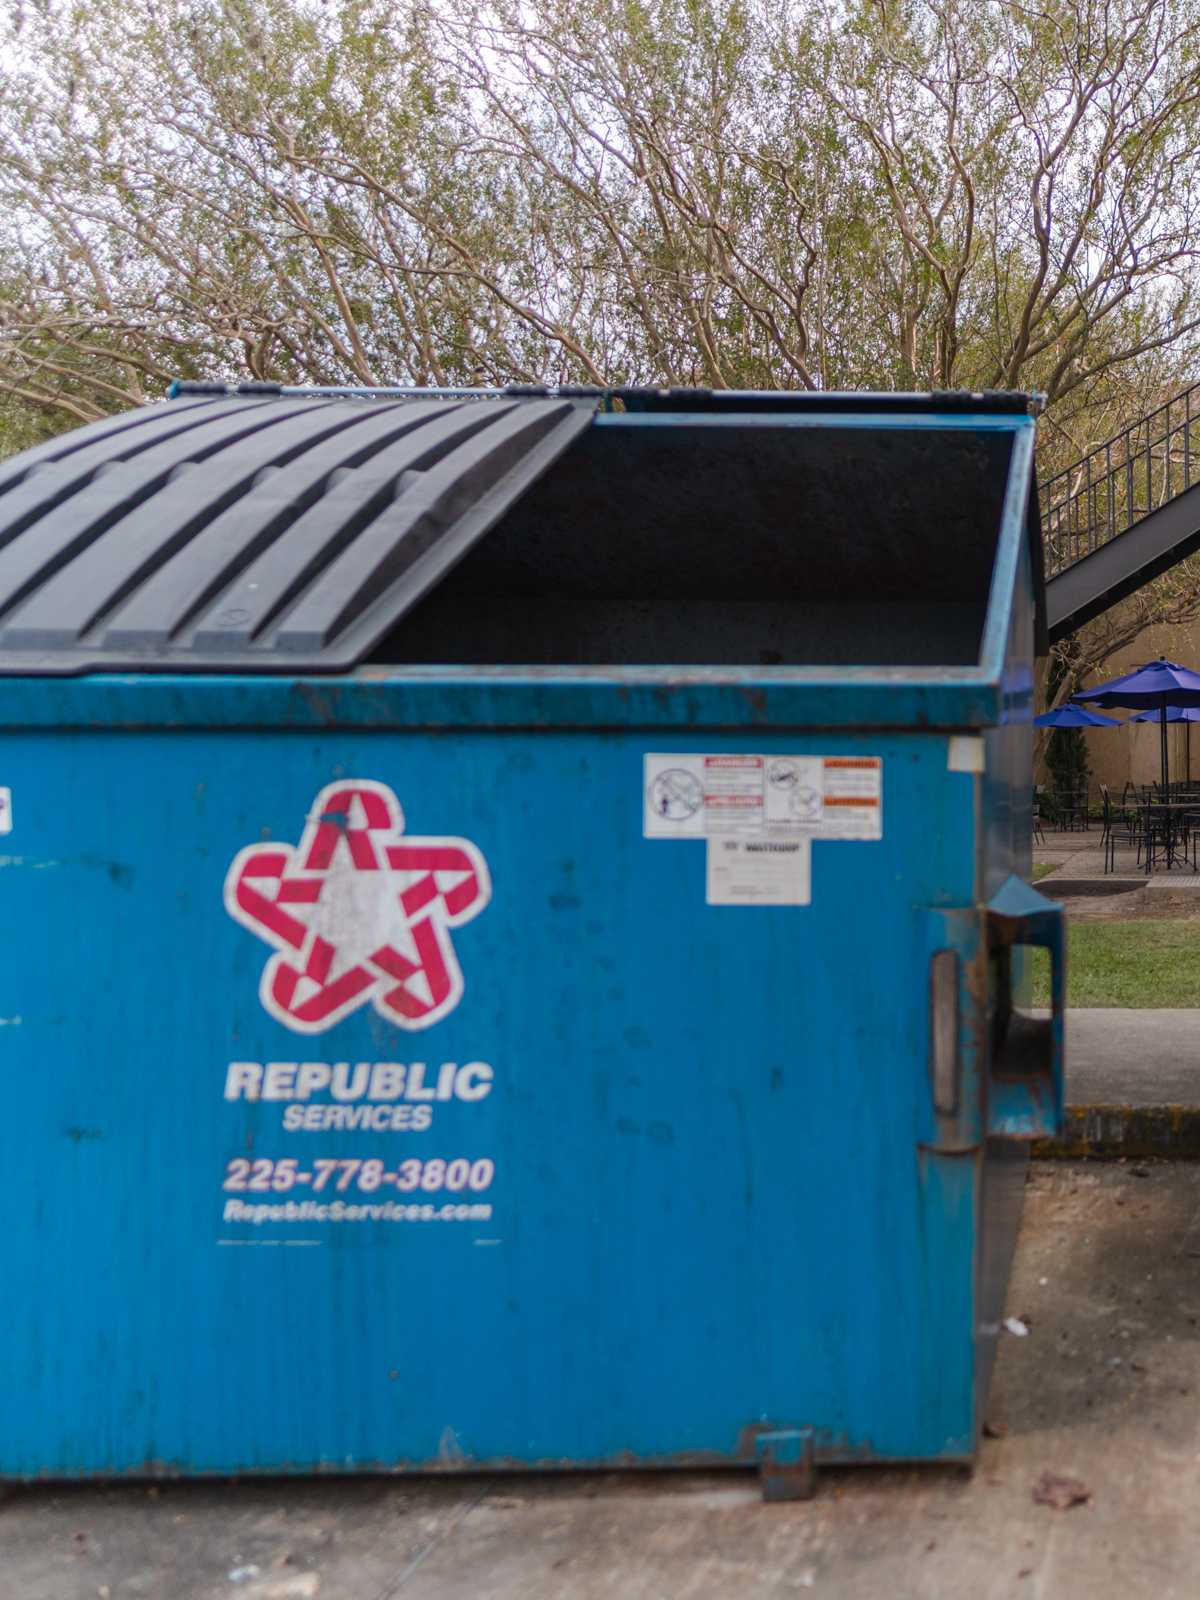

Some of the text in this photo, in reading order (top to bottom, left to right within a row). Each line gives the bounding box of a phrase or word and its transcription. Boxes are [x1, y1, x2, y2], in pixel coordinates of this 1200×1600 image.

[224, 1062, 494, 1101] REPUBLIC
[282, 1104, 433, 1131] SERVICES
[223, 1158, 494, 1192] 225-778-3800
[223, 1199, 493, 1224] RepublicServices.com
